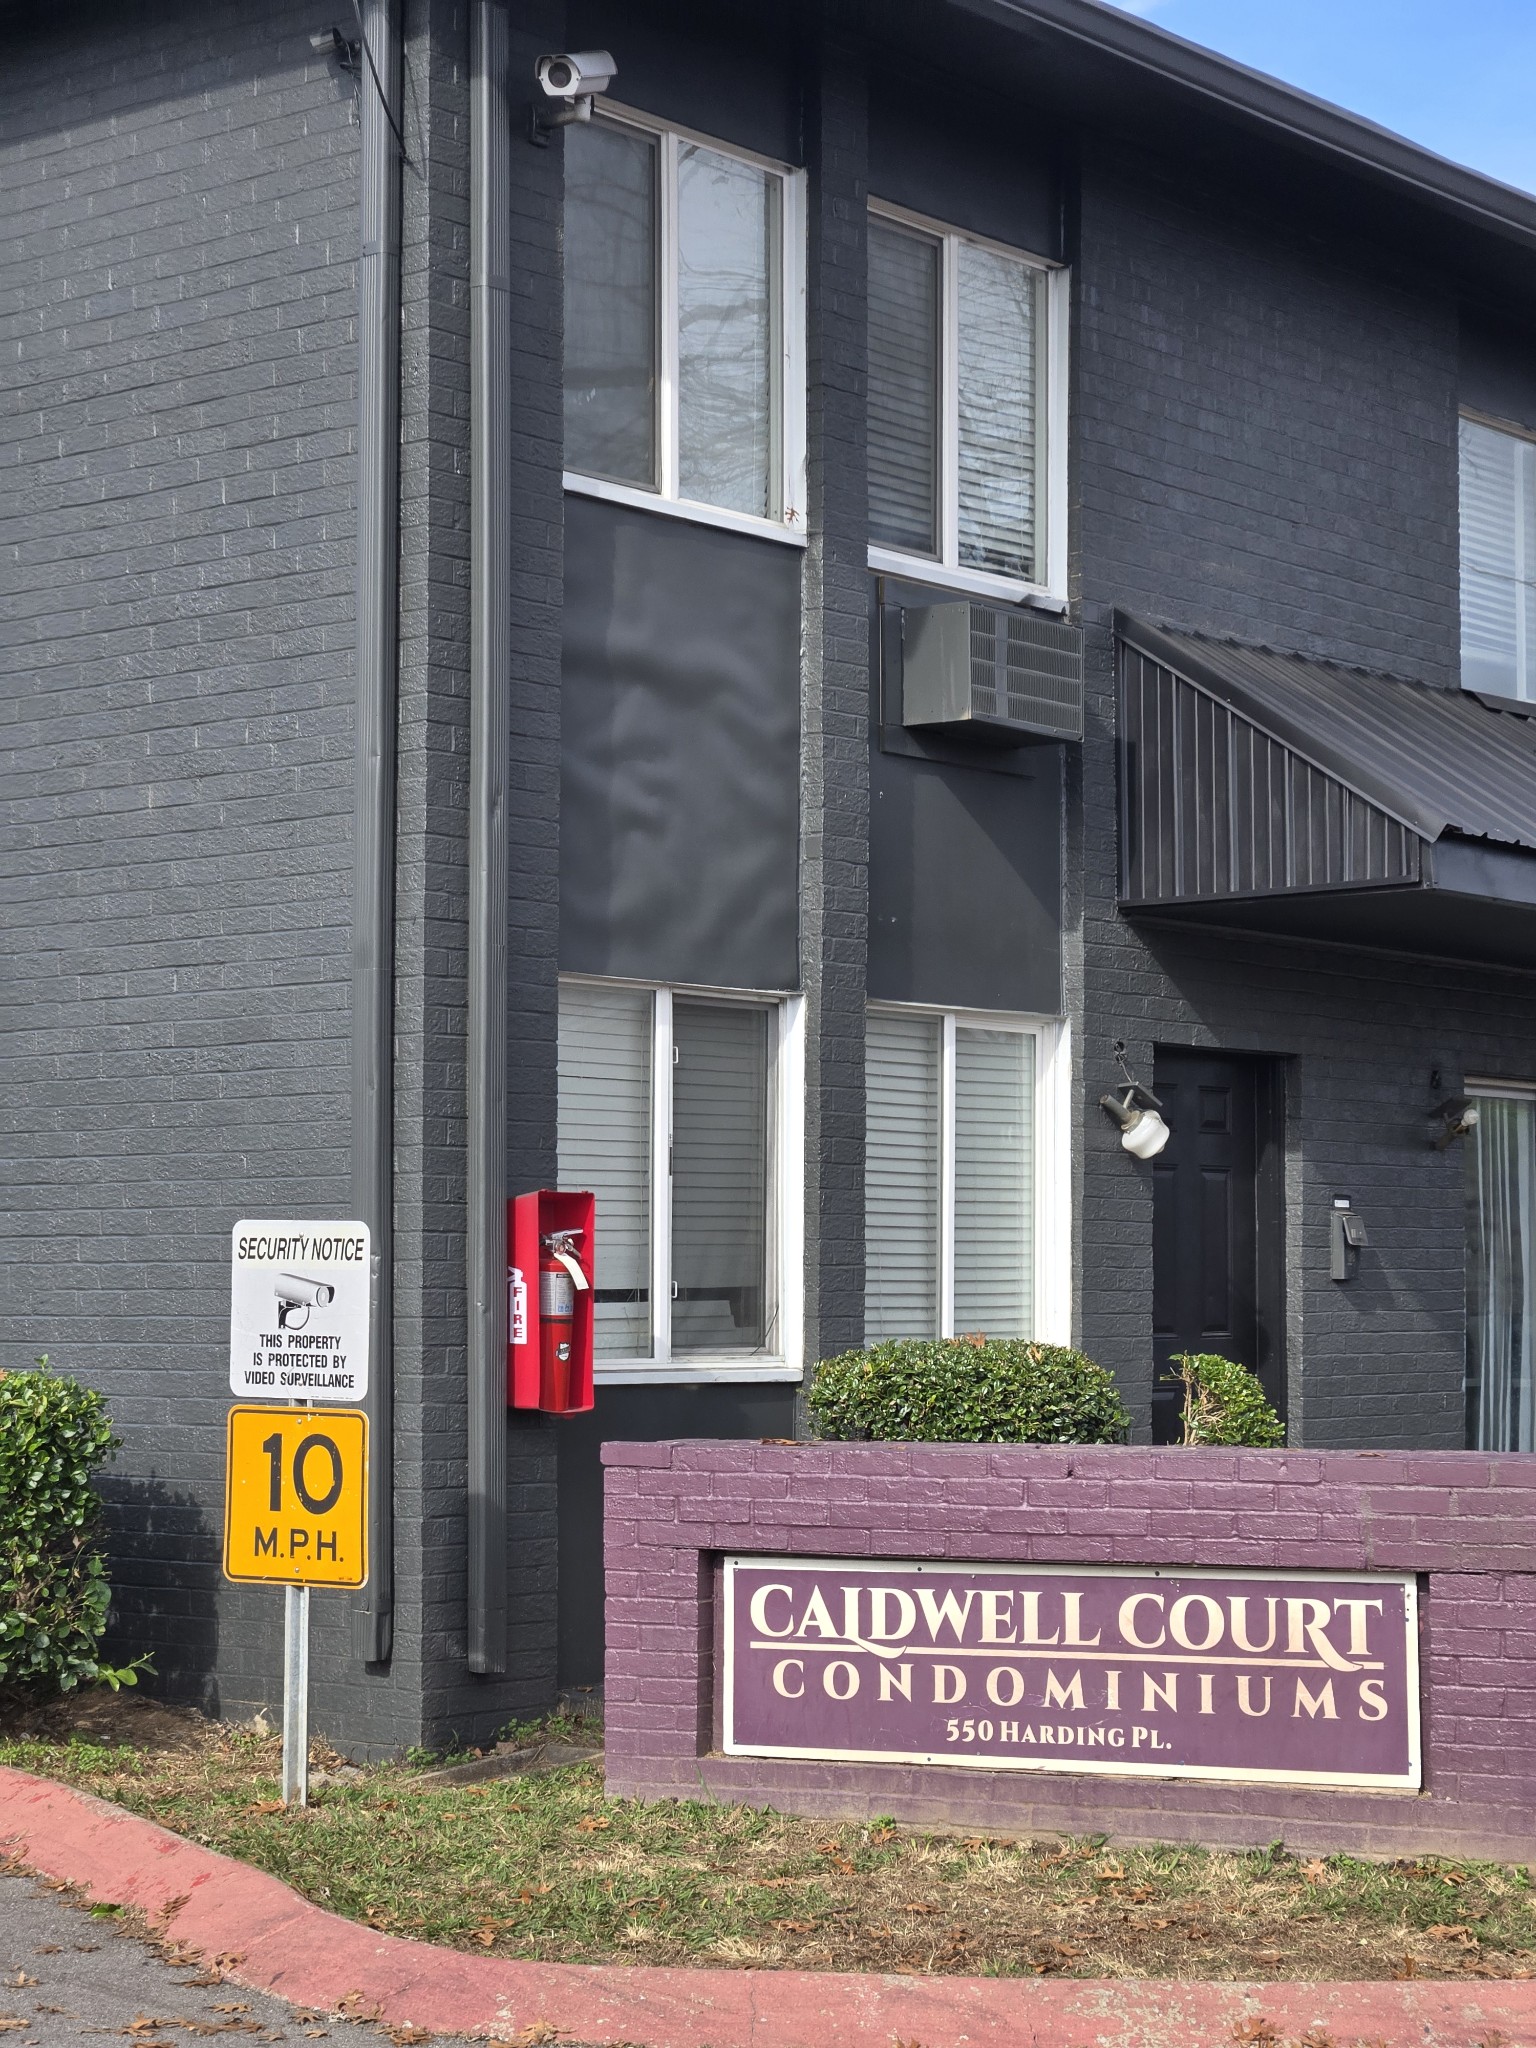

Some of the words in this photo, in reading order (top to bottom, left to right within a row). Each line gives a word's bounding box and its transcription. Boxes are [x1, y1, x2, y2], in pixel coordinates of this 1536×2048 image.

[238, 1237, 309, 1260] SECURITY
[311, 1237, 364, 1261] NOTICE
[513, 1286, 523, 1338] FIRE
[260, 1334, 282, 1348] THIS
[287, 1334, 341, 1349] PROPERTY
[253, 1352, 263, 1366] IS
[268, 1353, 328, 1368] PROTECTED
[333, 1355, 347, 1369] BY
[244, 1371, 275, 1385] VIDEO
[280, 1372, 355, 1388] SURVEILLANCE
[262, 1432, 343, 1515] 10
[254, 1526, 345, 1563] M.P.H.
[750, 1583, 1101, 1659] CALDWELL
[1118, 1592, 1383, 1672] COURT
[772, 1659, 1389, 1722] CONDOMINIUMS
[946, 1719, 994, 1742] 550
[999, 1720, 1125, 1748] HARDING
[1131, 1726, 1172, 1749] PL.
